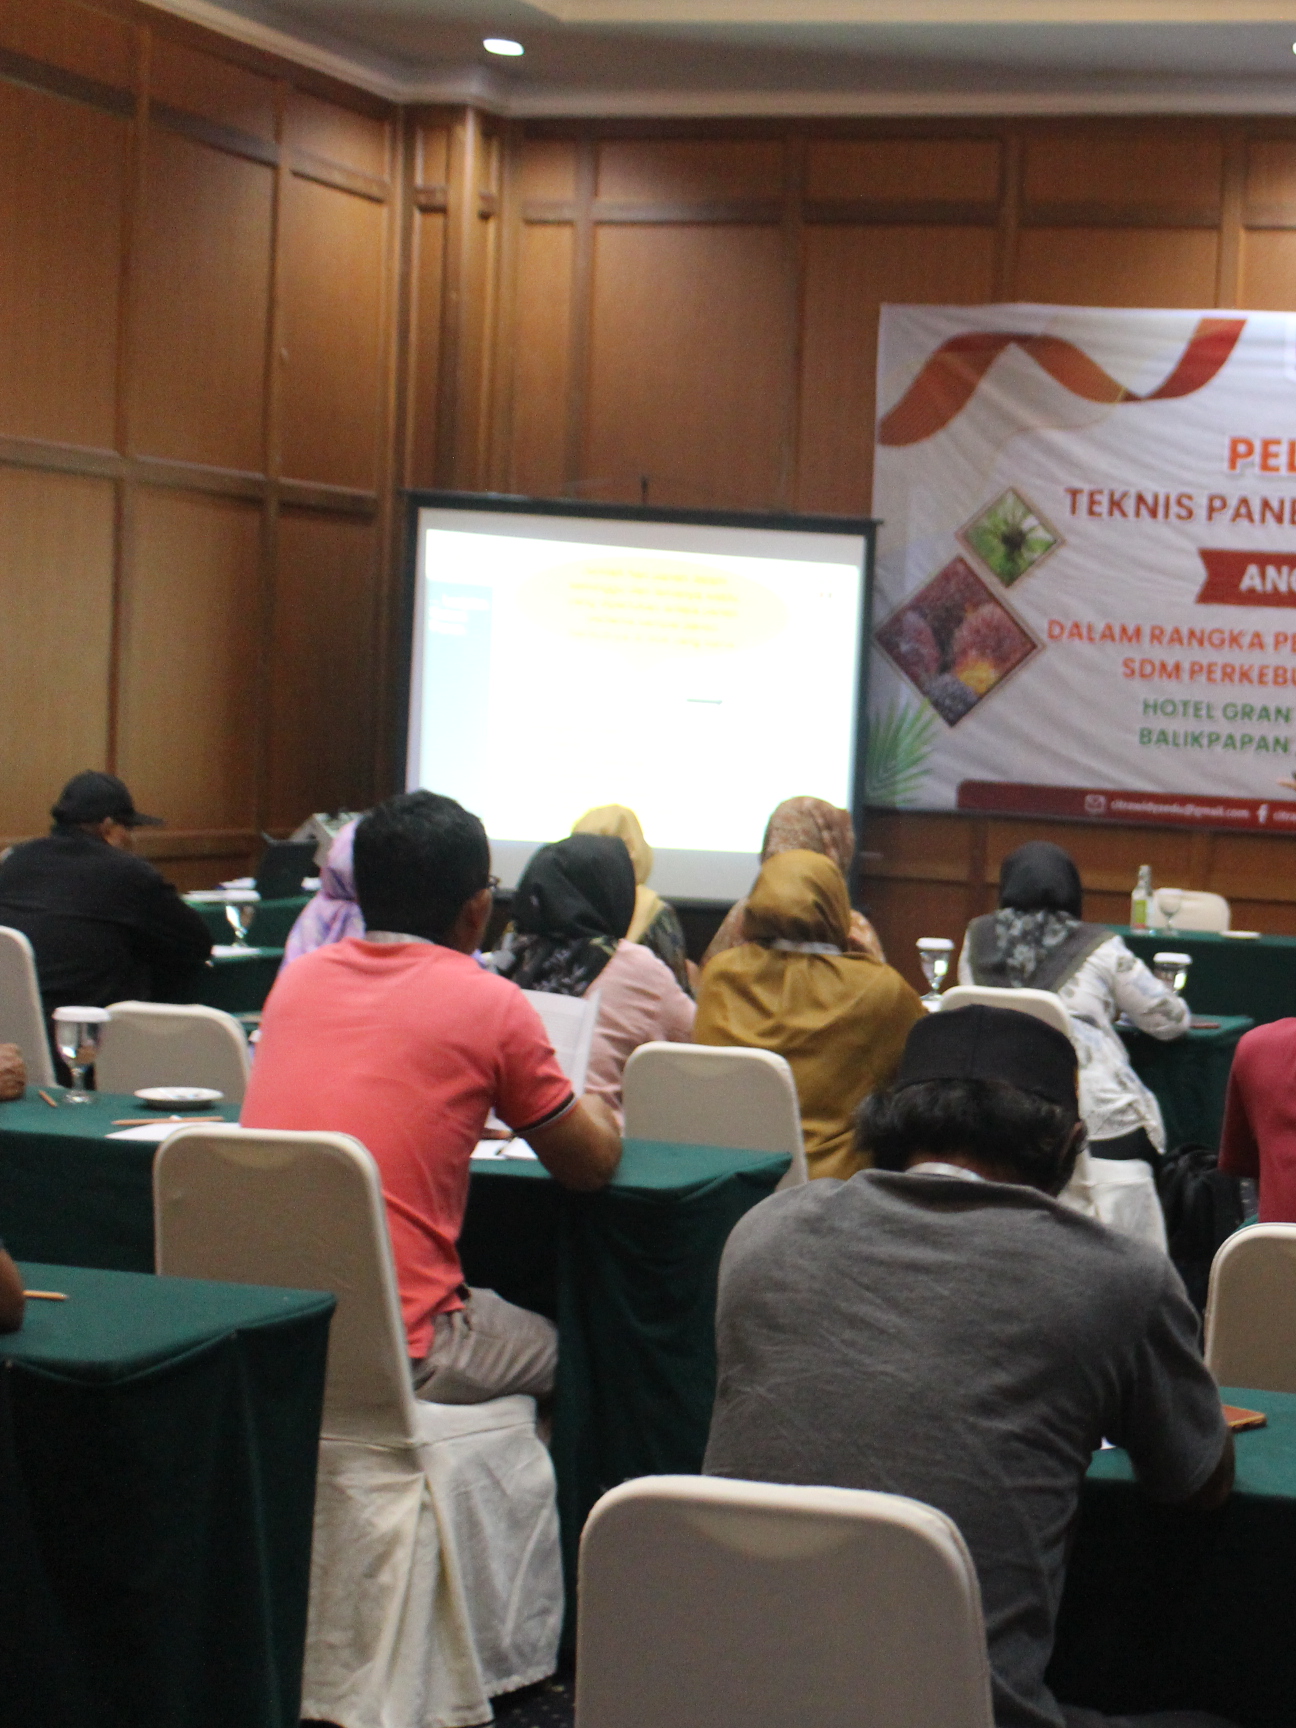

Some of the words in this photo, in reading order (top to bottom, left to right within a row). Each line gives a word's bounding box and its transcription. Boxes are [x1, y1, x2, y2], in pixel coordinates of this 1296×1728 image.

[1064, 487, 1195, 521] TEKNIS
[1046, 619, 1142, 644] DALAM
[1149, 624, 1265, 652] RANGKA
[1122, 657, 1181, 681] SDM
[1142, 699, 1214, 719] HOTEL
[1222, 702, 1290, 723] GRAN
[1139, 727, 1288, 753] BALIKPAPAN
